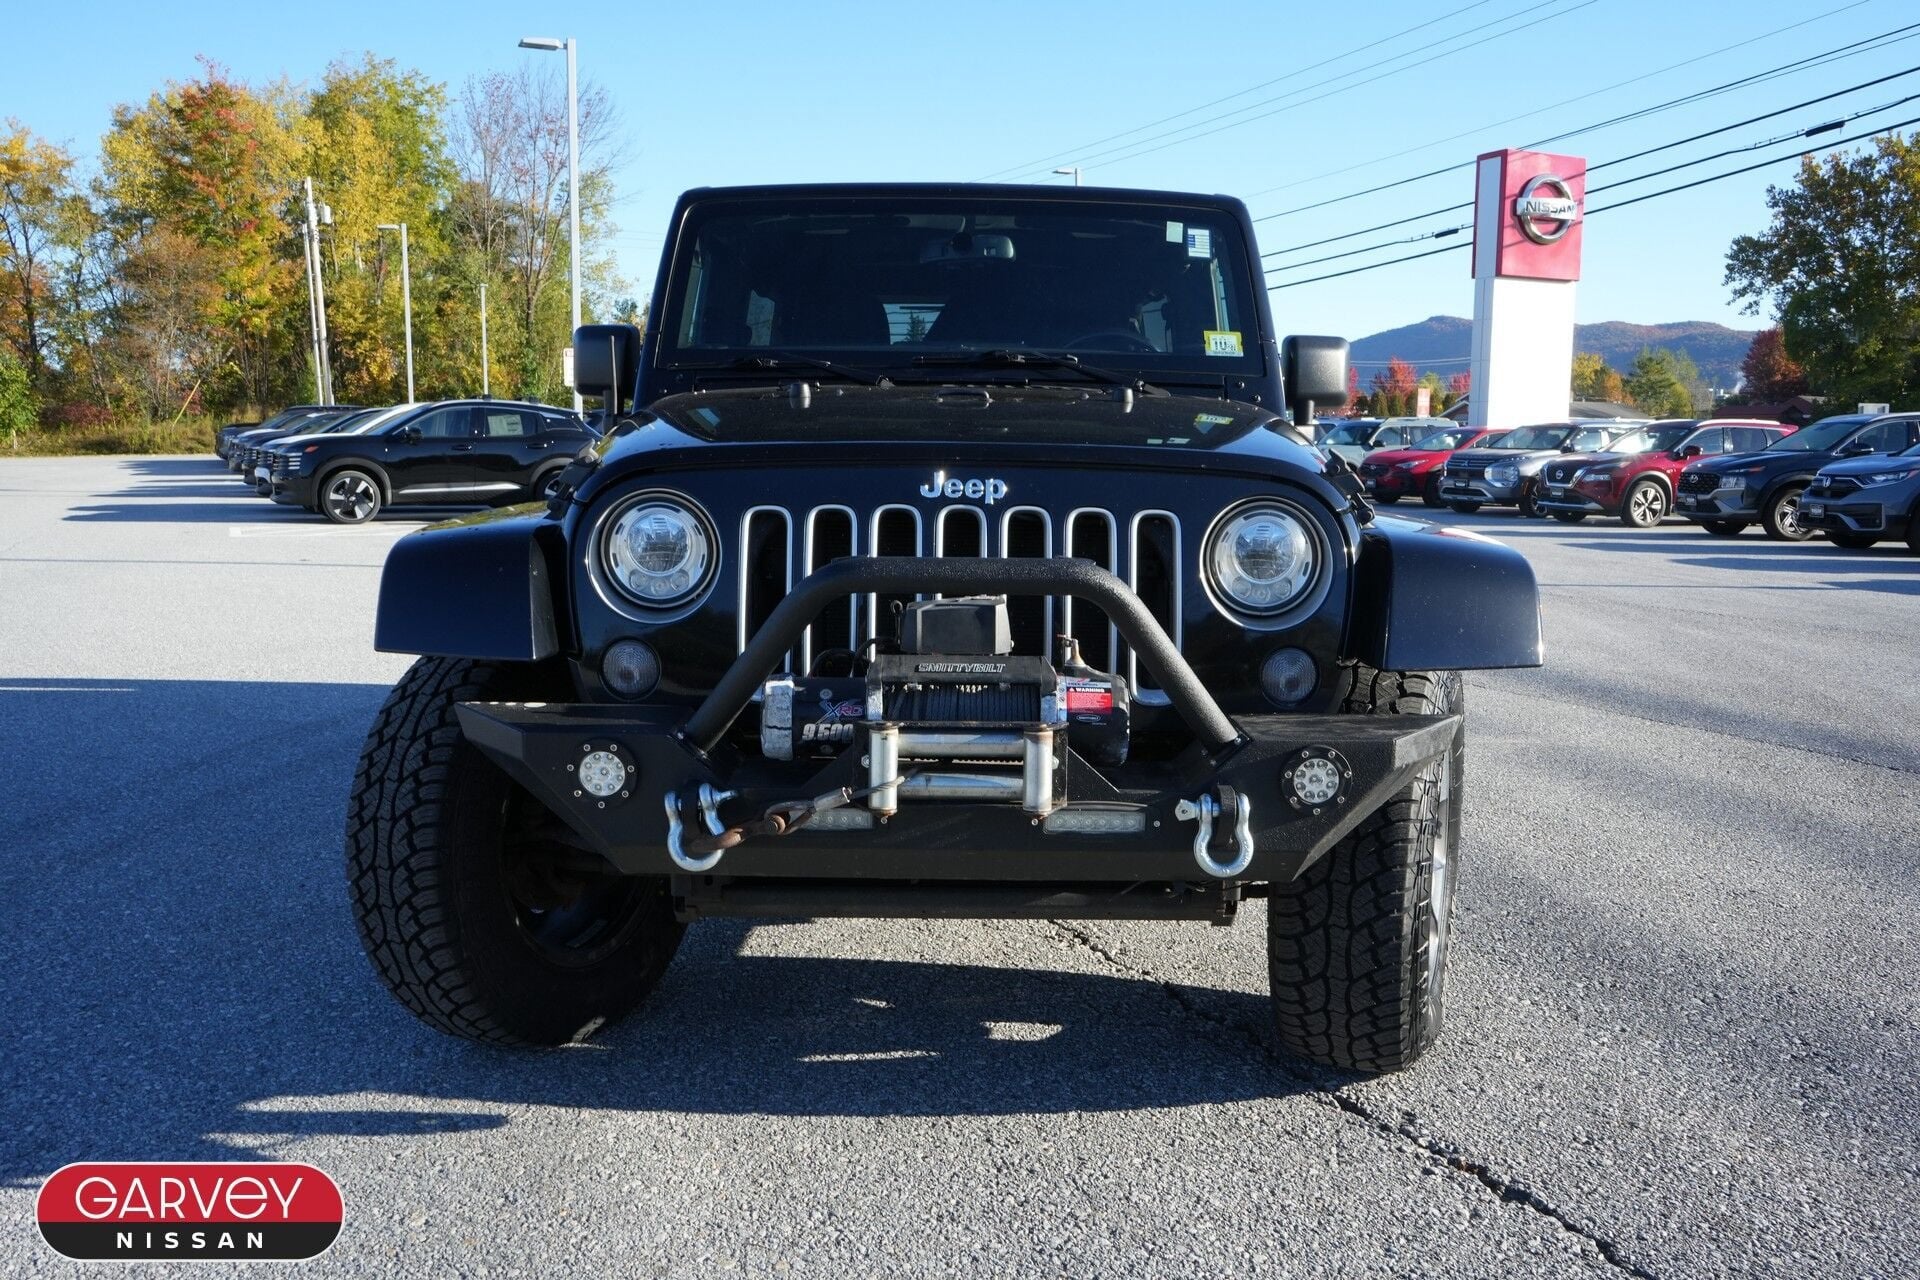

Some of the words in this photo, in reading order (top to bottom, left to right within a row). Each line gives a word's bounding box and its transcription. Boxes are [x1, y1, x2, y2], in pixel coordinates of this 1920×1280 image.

[1525, 200, 1575, 215] NISSAN
[919, 470, 1008, 505] Jeep
[917, 662, 1006, 673] SMITTYBILT
